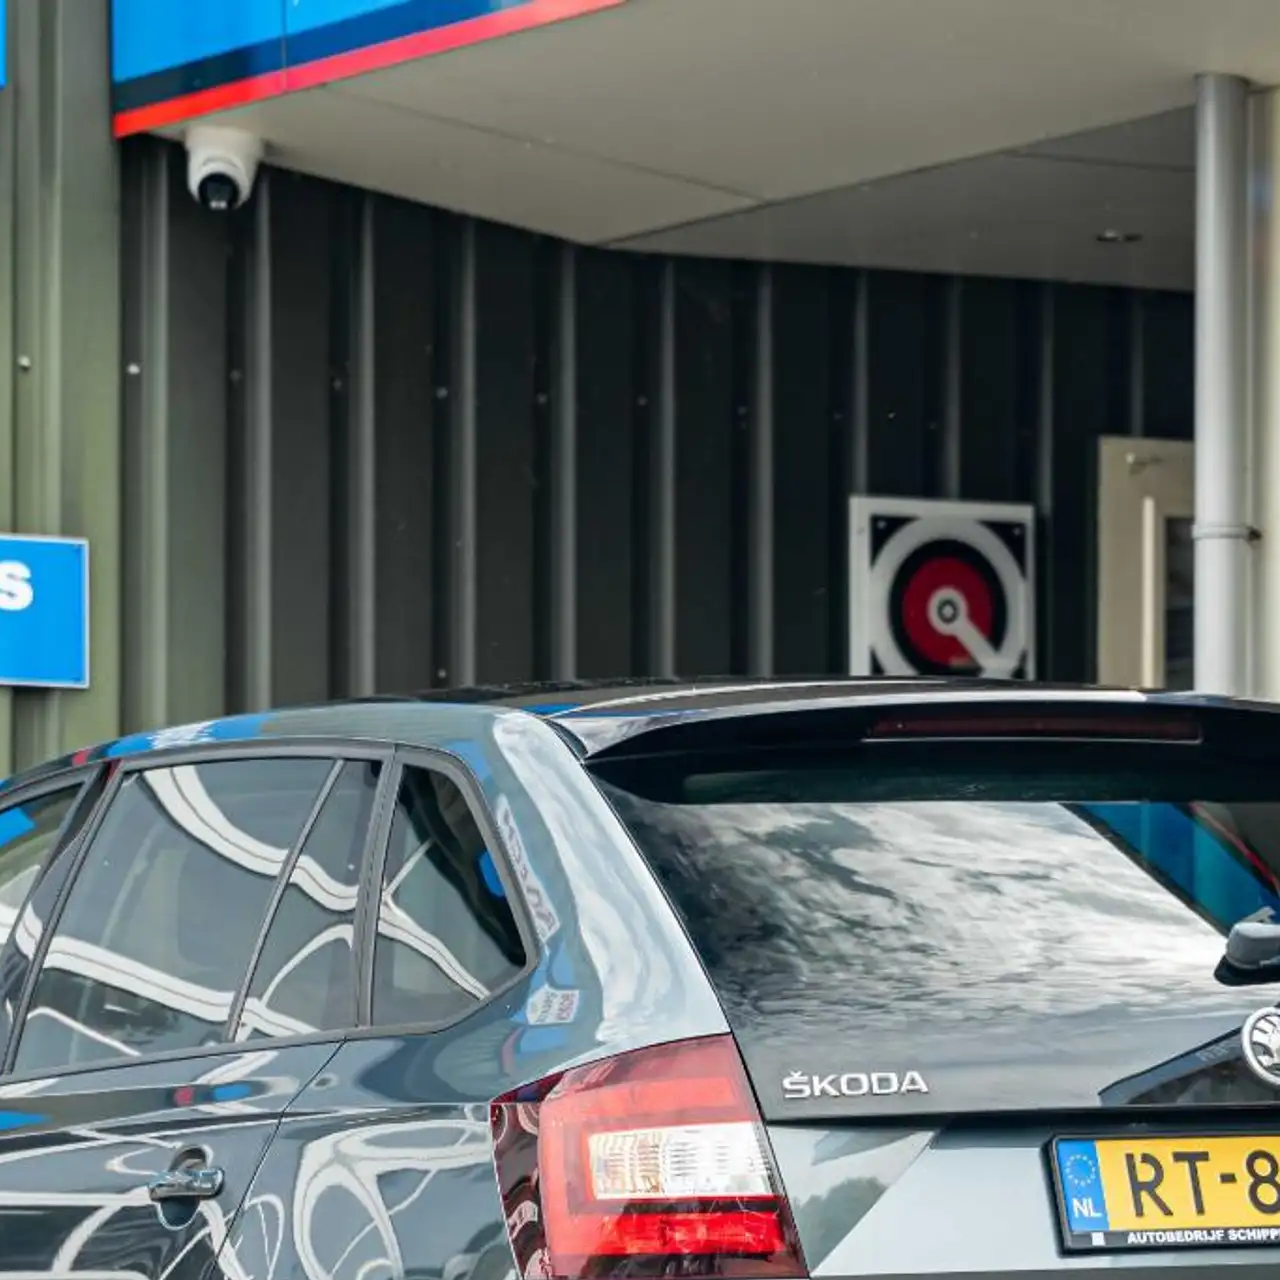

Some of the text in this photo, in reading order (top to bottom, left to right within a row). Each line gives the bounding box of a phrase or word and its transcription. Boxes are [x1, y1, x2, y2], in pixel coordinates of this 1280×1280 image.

[782, 1070, 929, 1099] ŠKODA
[1072, 1198, 1102, 1218] NL
[1127, 1229, 1225, 1245] AUTOBEDRIJF
